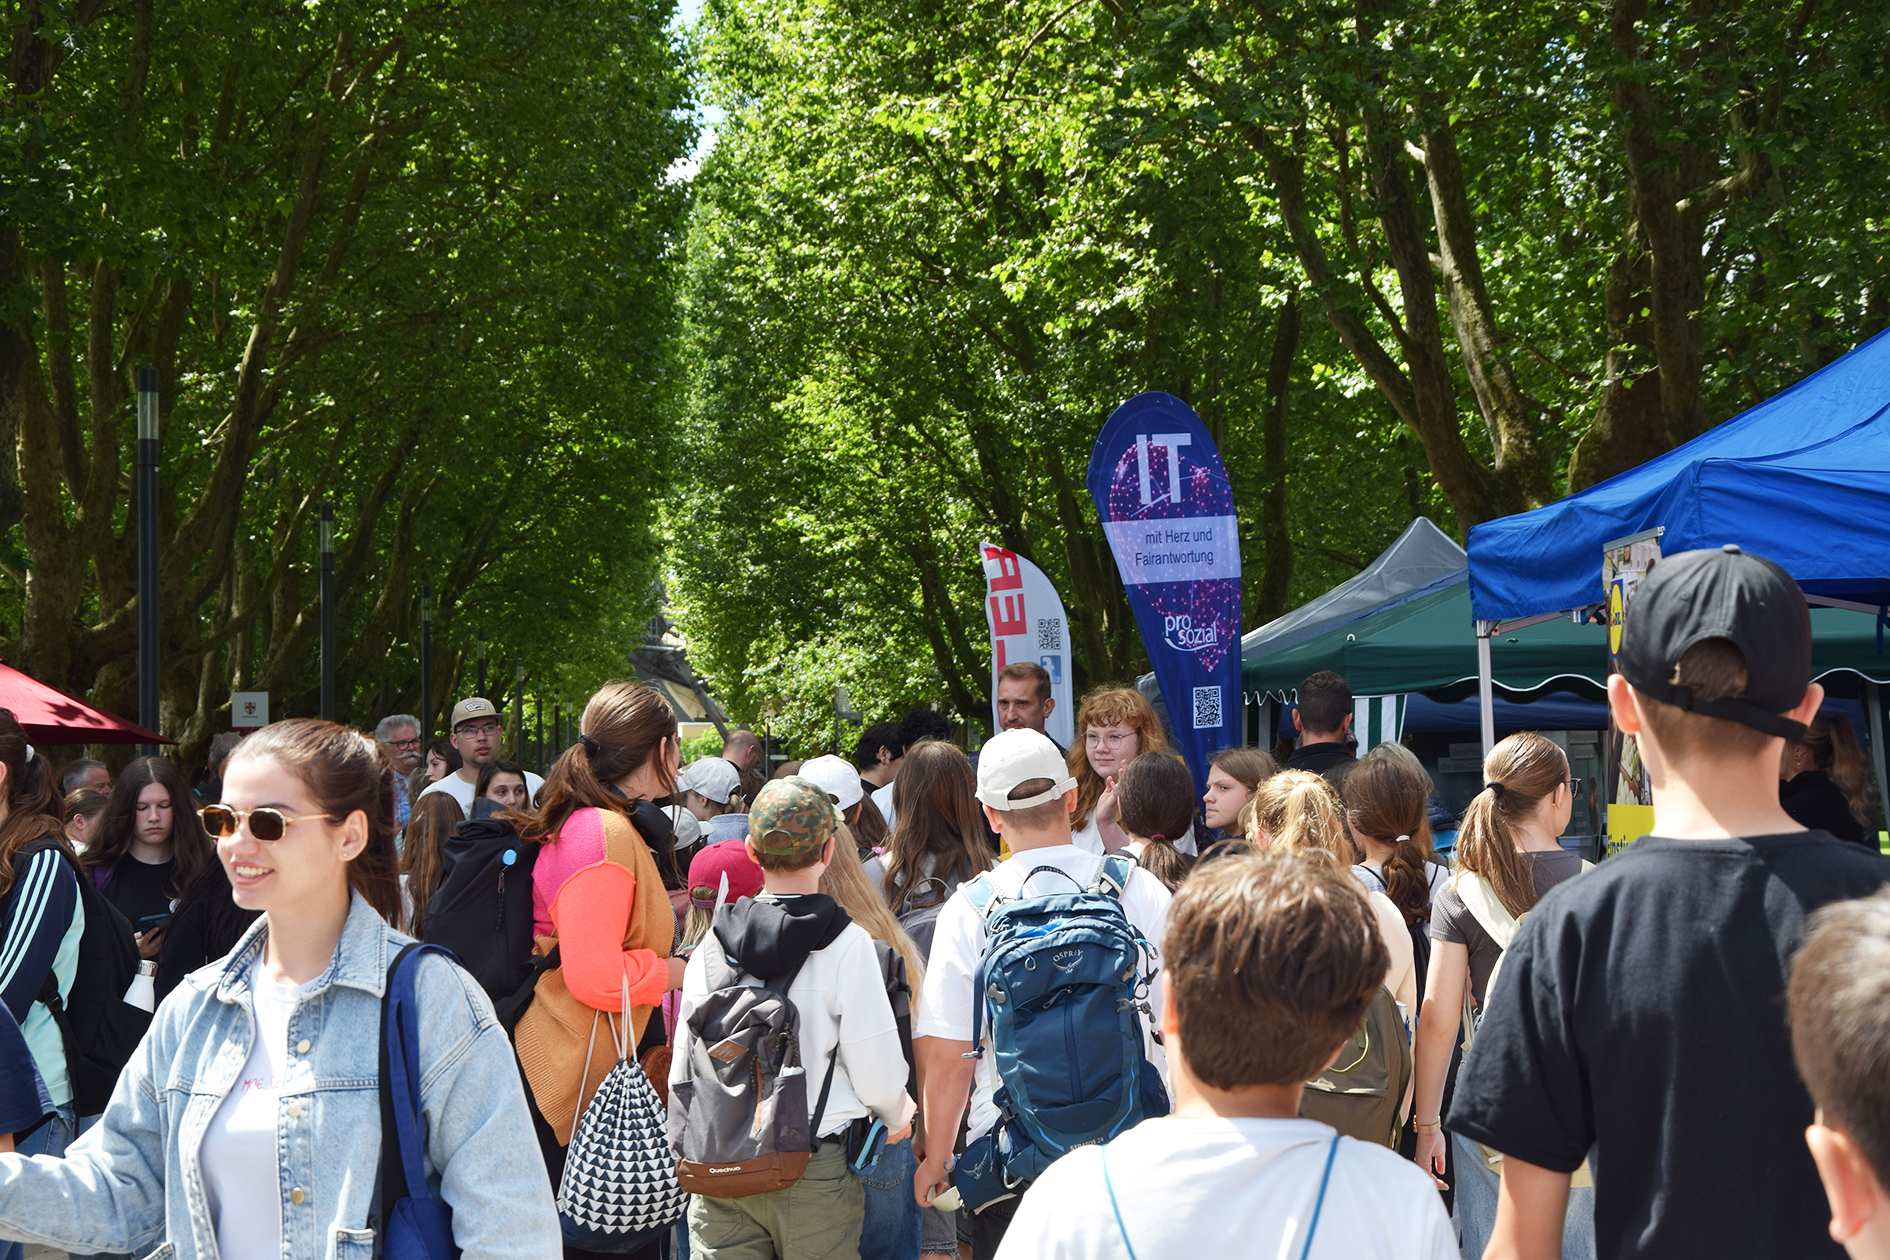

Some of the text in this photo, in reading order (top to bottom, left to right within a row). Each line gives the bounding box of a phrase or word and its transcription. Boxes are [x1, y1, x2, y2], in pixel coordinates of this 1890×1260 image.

[1135, 432, 1192, 505] IT
[1145, 528, 1212, 544] mit Herz und
[1135, 550, 1213, 566] Fairantwortung
[1165, 615, 1191, 637] pro
[1178, 621, 1218, 645] sozial
[1053, 949, 1083, 962] OSPREY
[709, 1166, 741, 1174] Quechua
